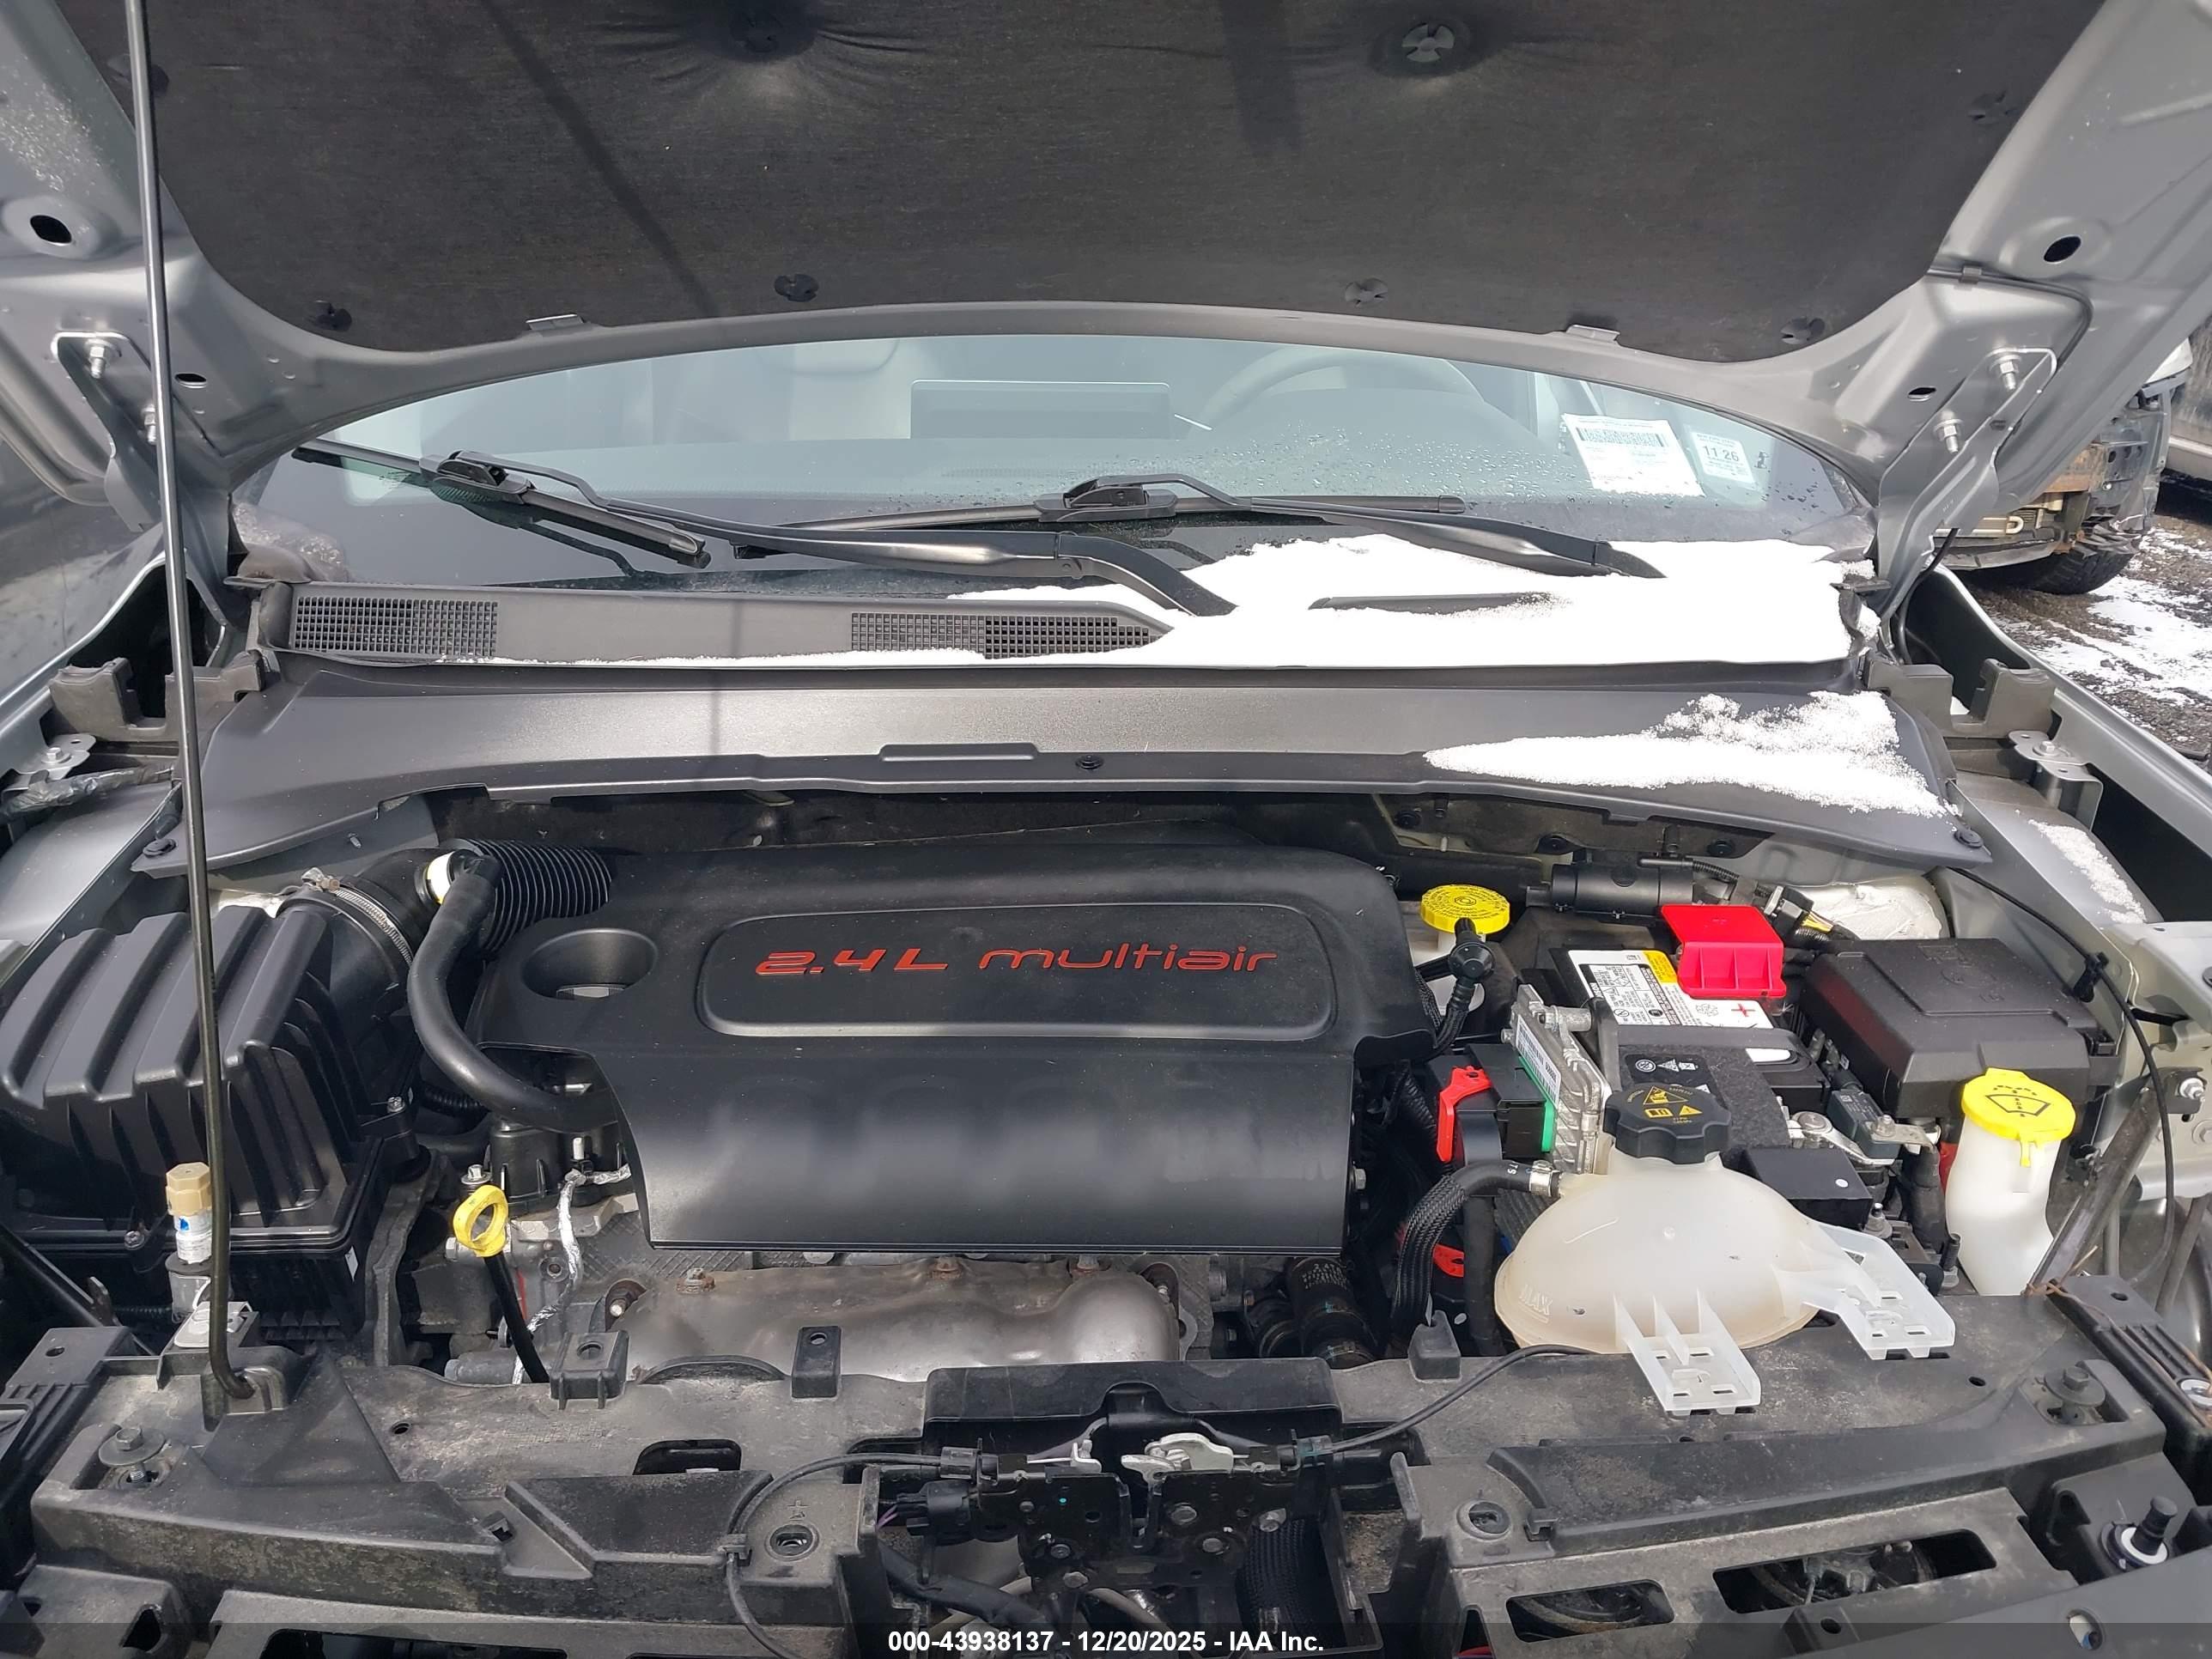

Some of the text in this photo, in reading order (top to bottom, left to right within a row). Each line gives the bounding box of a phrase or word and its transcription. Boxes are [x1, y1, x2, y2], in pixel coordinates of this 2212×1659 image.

[1703, 445, 1741, 462] 11 26
[978, 942, 1277, 971] multiair
